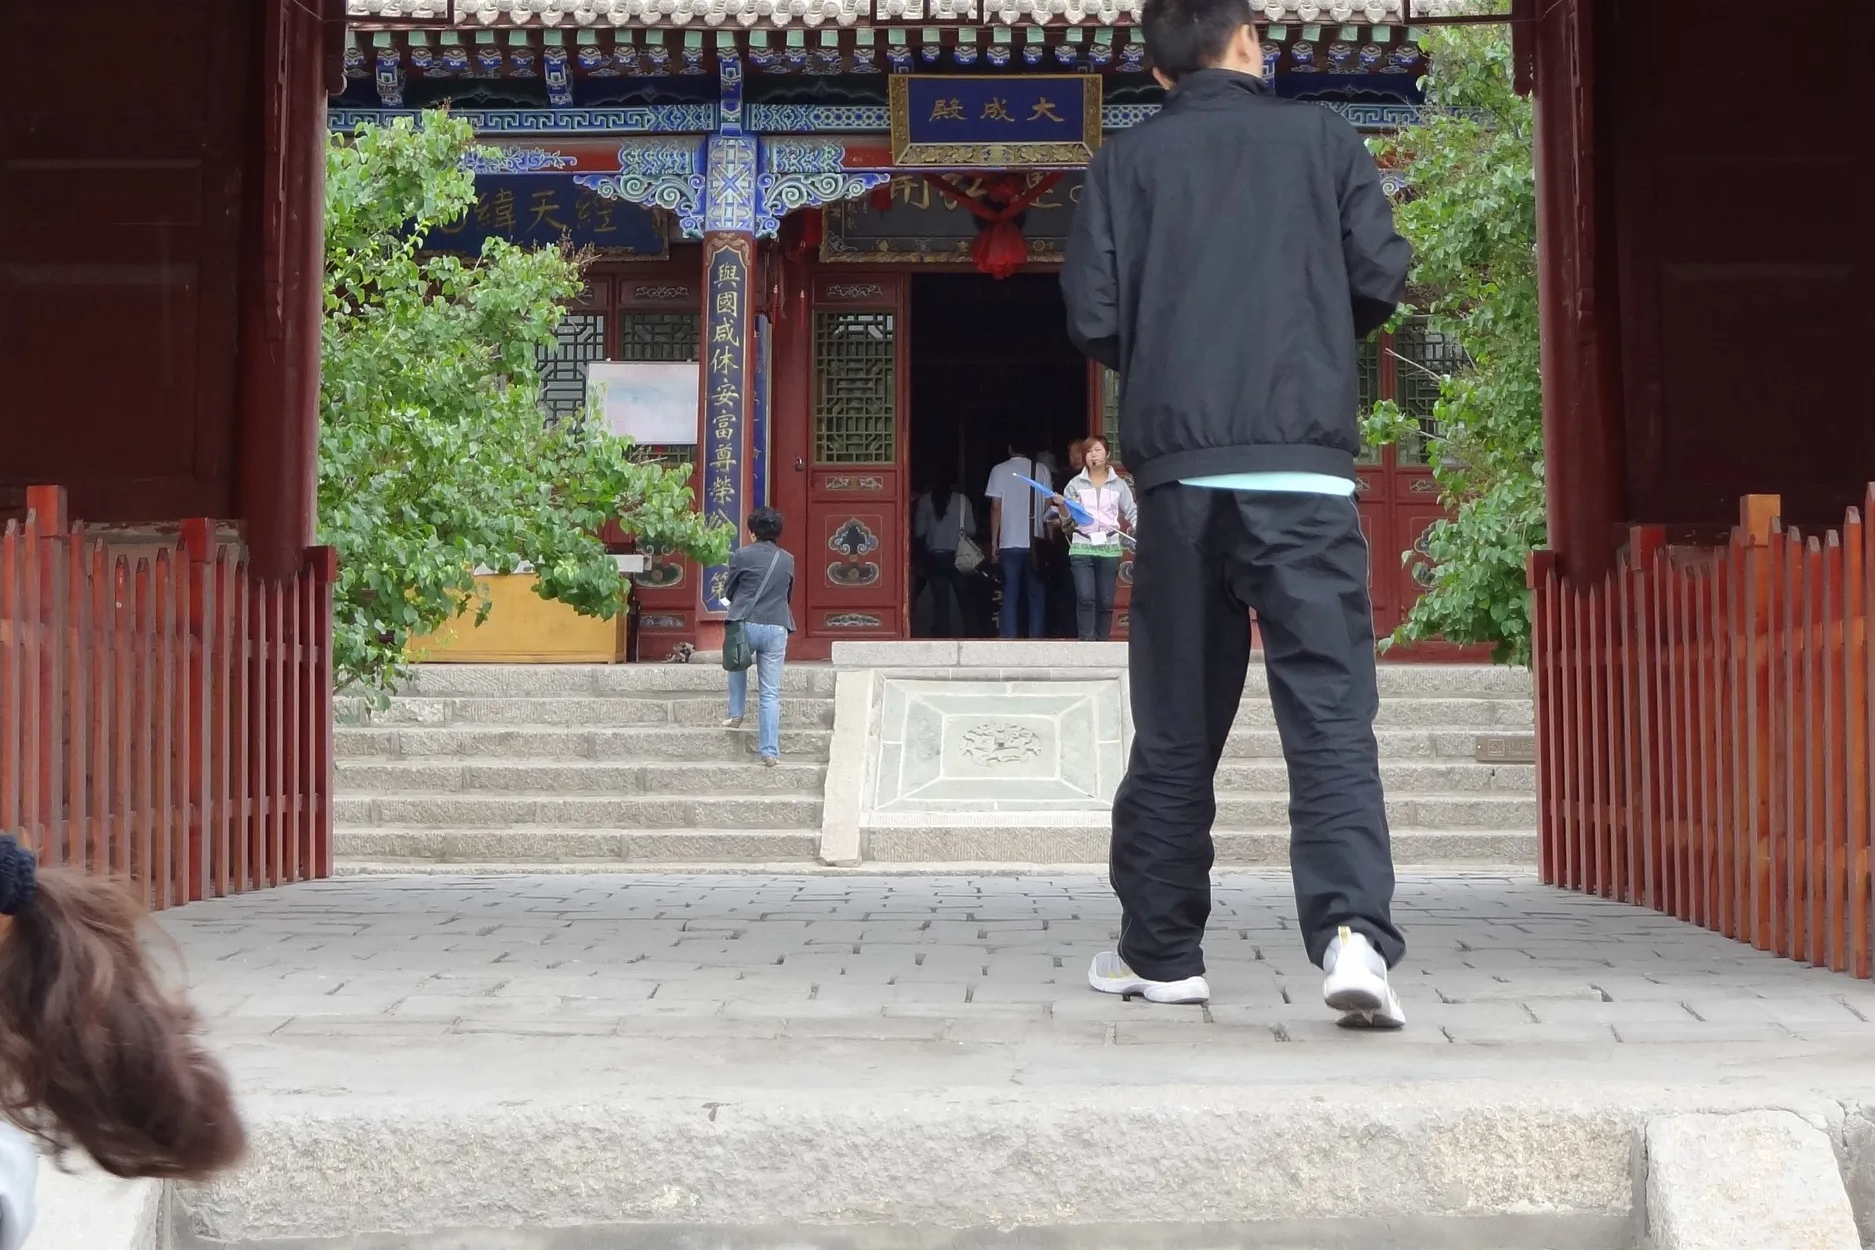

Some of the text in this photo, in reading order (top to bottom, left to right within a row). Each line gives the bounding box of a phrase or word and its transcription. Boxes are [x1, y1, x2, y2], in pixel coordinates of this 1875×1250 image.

[929, 96, 1065, 122] 大成殿
[439, 187, 618, 235] 經天緯
